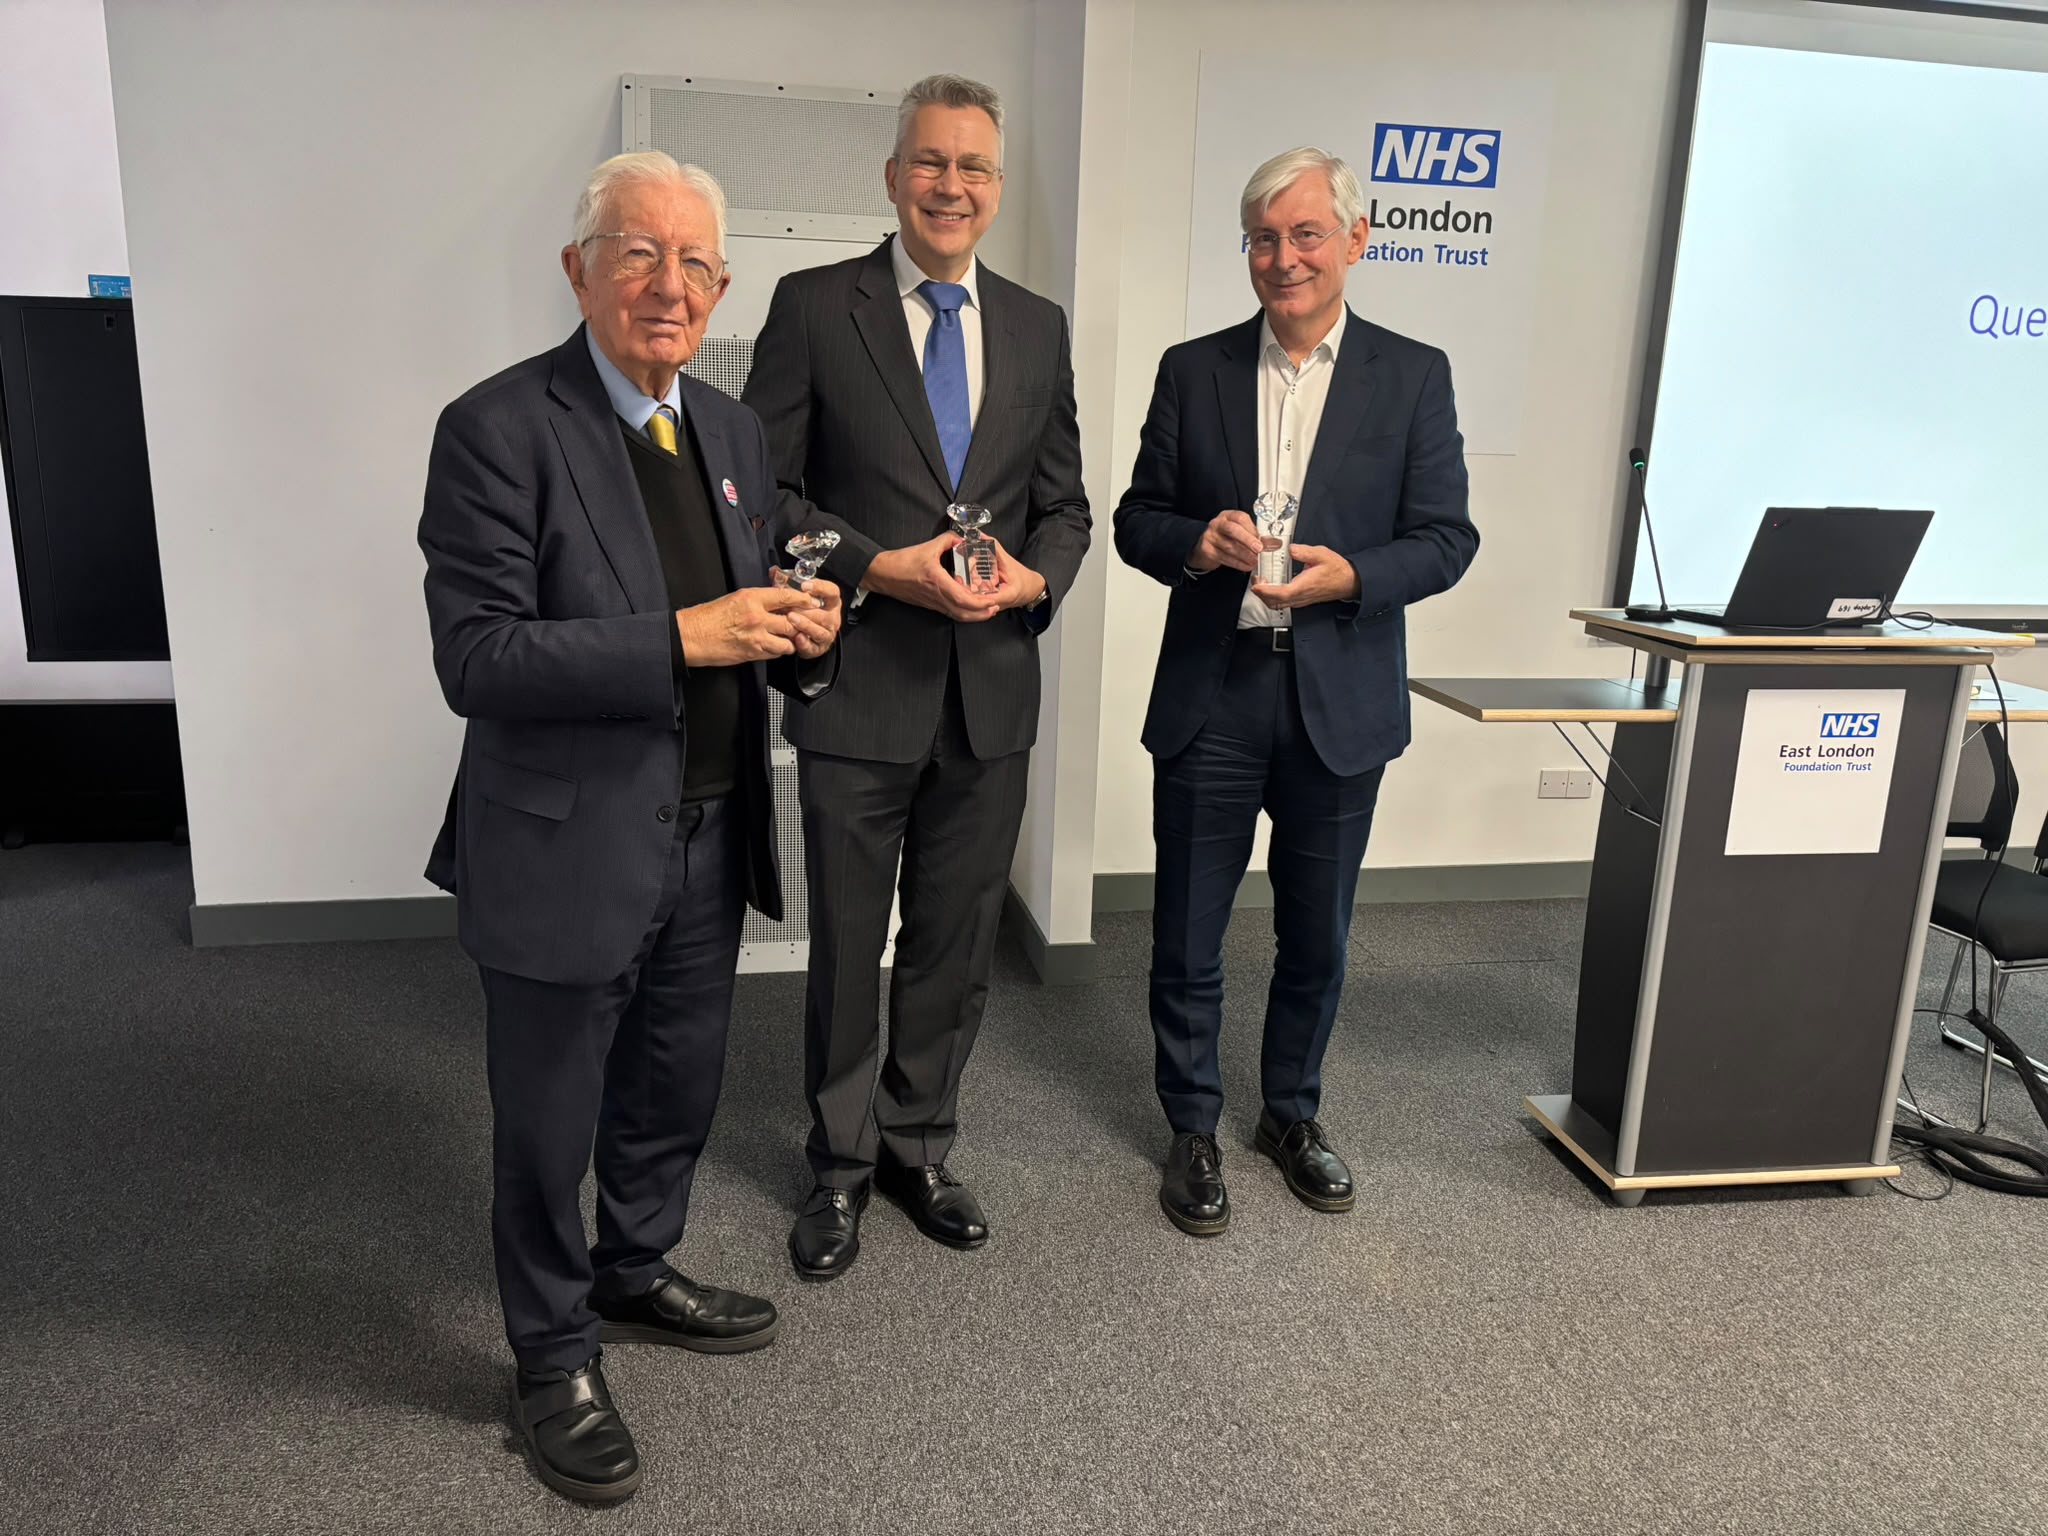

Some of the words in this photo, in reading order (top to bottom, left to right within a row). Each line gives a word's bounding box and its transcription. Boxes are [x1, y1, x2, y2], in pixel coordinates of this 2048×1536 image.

[1374, 128, 1497, 184] NHS
[1369, 199, 1493, 234] London
[1434, 244, 1489, 266] Trust
[1969, 295, 2047, 339] Que
[1821, 714, 1878, 737] NHS
[1779, 745, 1812, 758] East
[1818, 744, 1875, 758] London
[1784, 762, 1842, 772] Foundation
[1846, 762, 1872, 771] Trust
